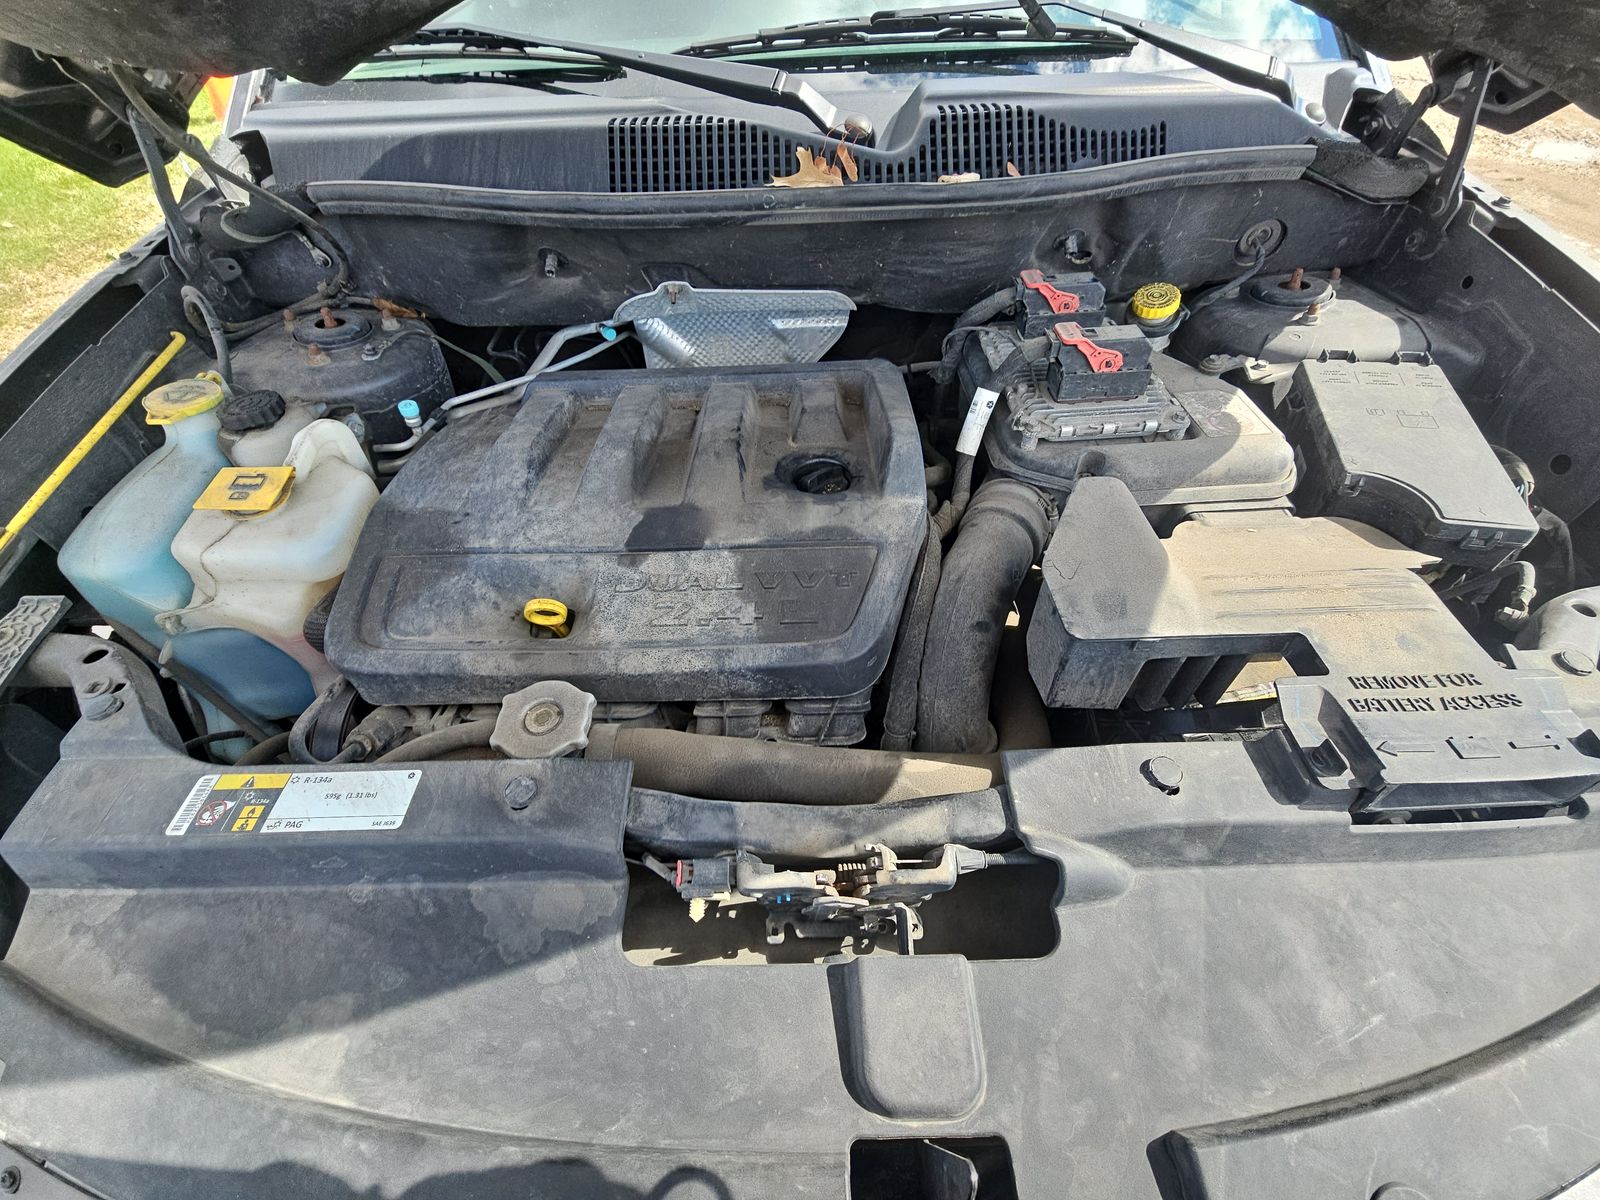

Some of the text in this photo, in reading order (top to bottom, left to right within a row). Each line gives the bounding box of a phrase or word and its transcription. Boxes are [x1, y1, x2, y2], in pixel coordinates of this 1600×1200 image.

[614, 570, 859, 594] DUAL VVT
[1347, 672, 1483, 690] REMOVE FOR
[1347, 693, 1524, 713] BATTERY ACCESS
[303, 776, 333, 785] R-134a
[324, 791, 378, 801] 595g (1.31 lbs)
[283, 820, 304, 829] PAG
